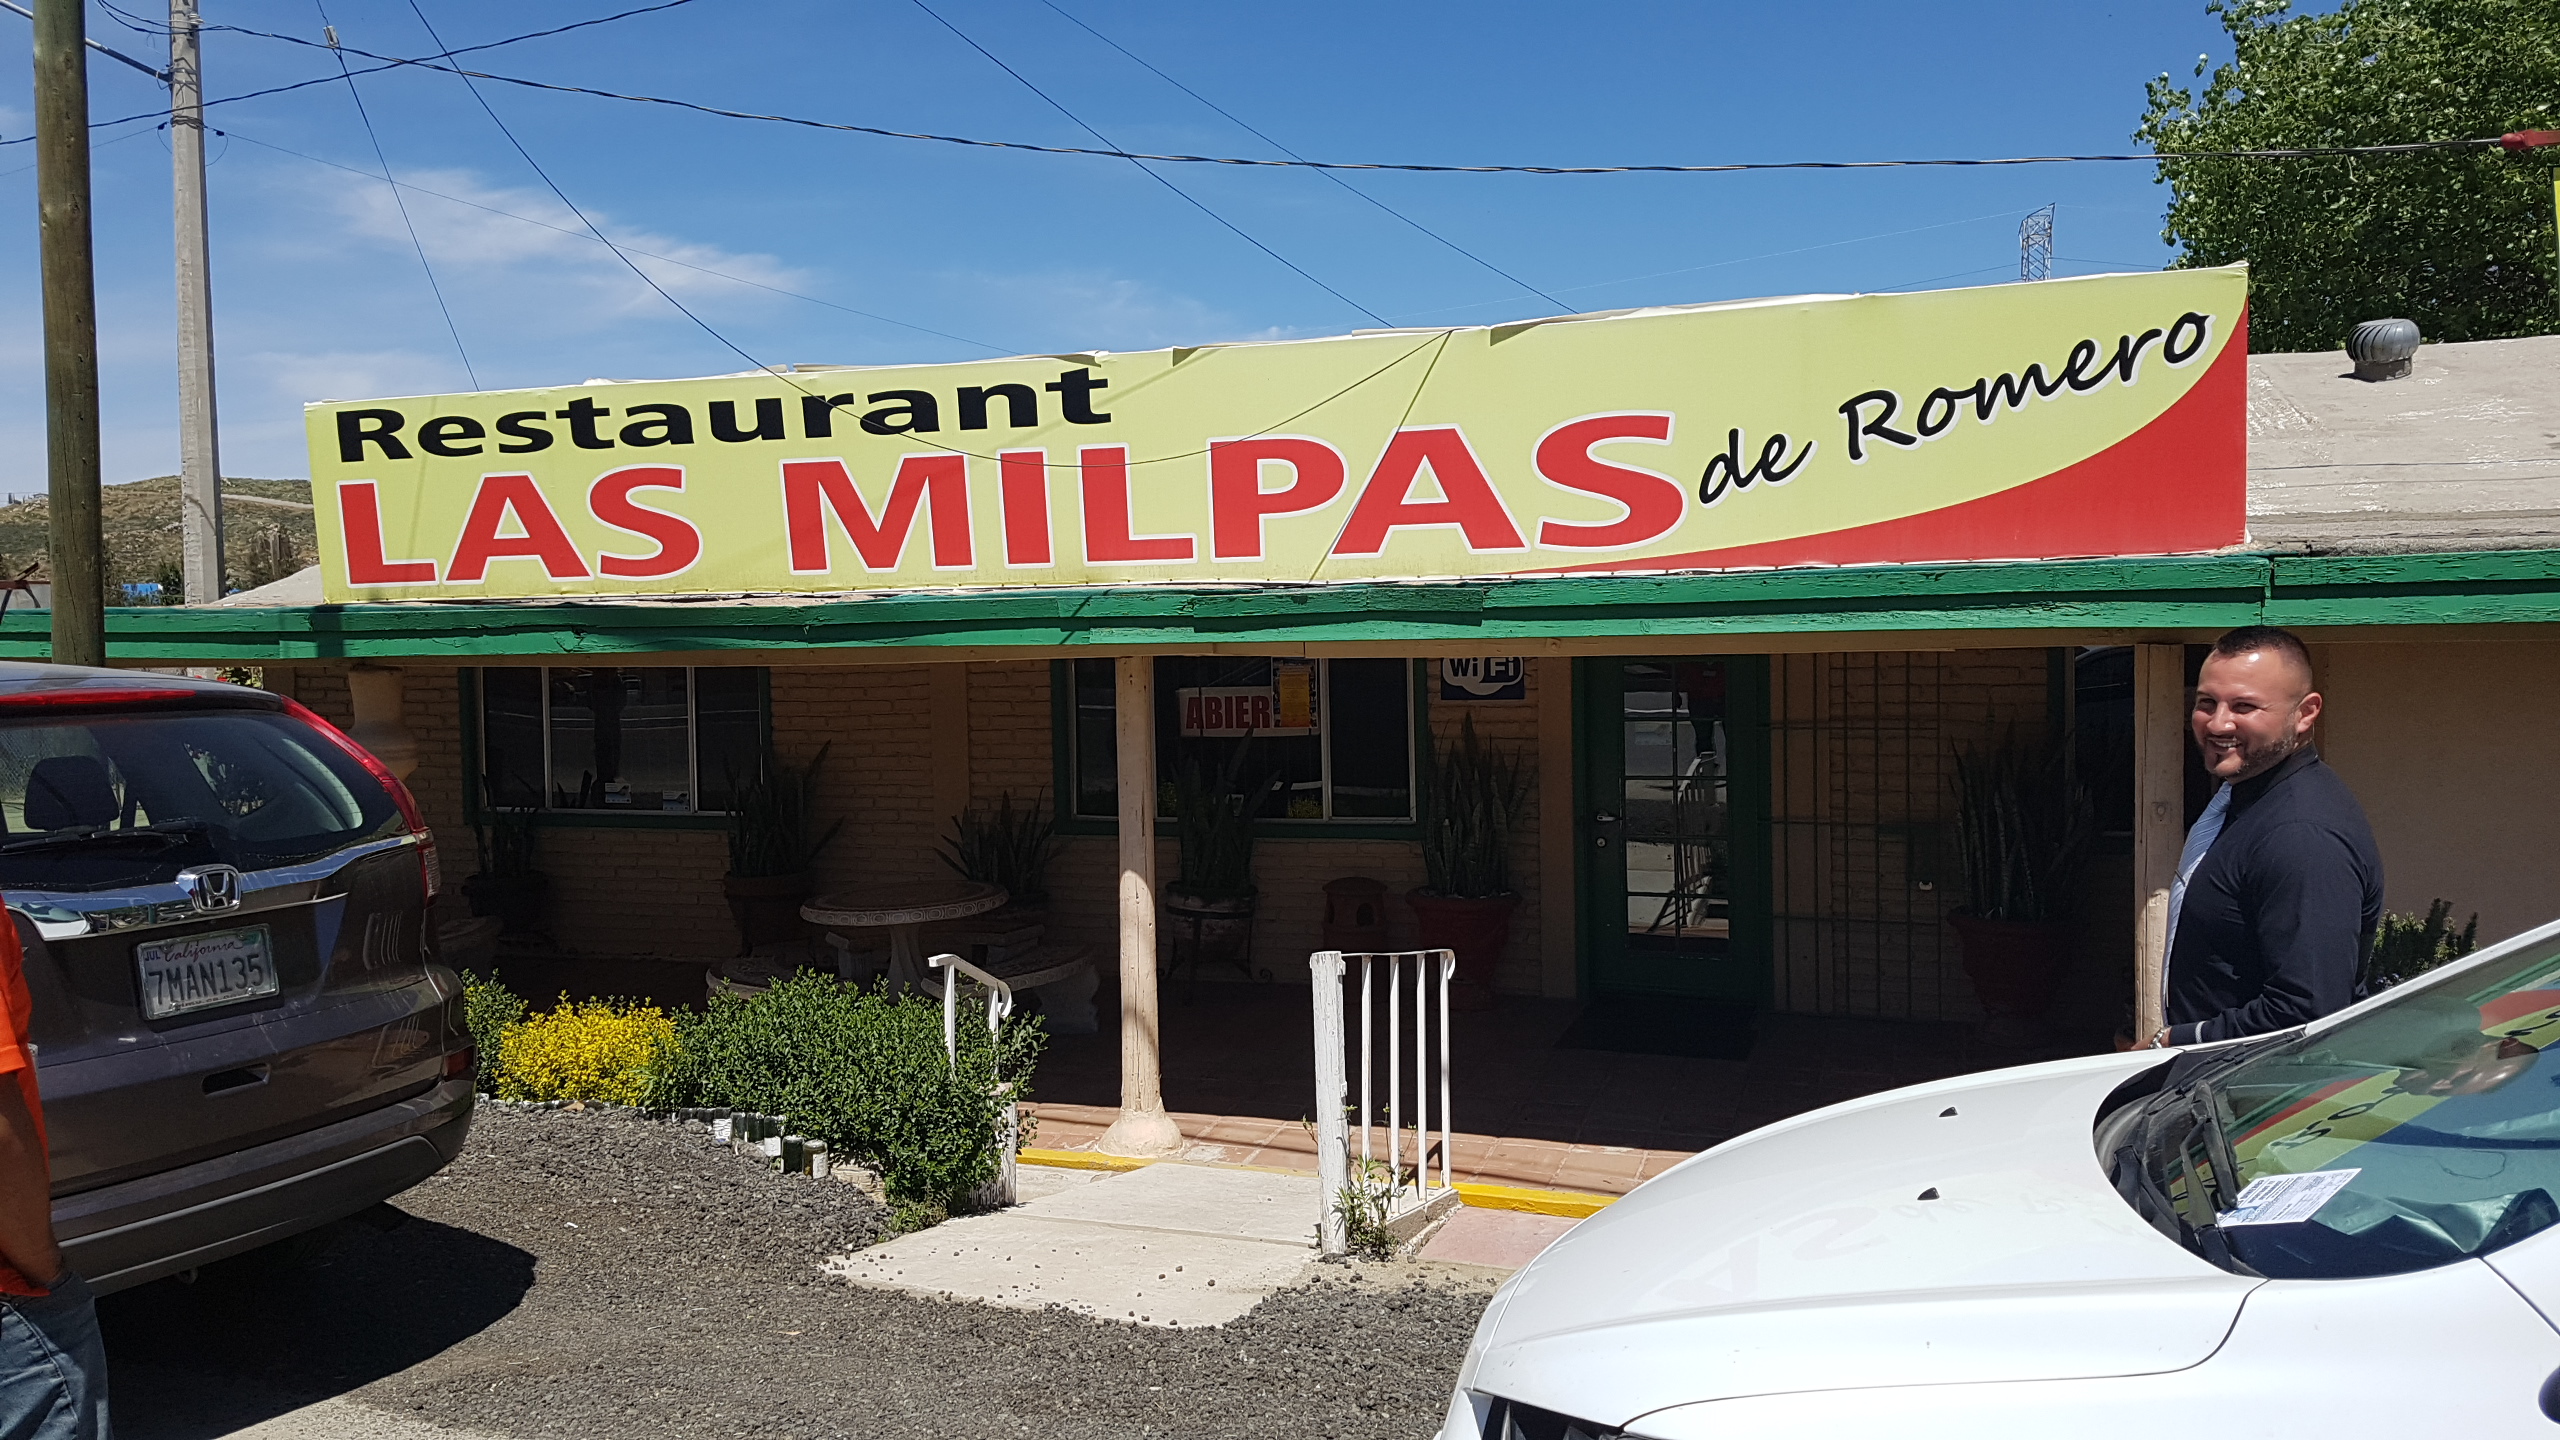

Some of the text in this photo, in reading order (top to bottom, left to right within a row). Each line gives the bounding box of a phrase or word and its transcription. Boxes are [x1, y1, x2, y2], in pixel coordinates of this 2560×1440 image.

[335, 367, 1113, 464] Restaurant
[1699, 311, 2210, 505] de Romero
[338, 412, 1687, 586] LAS MILPAS
[1185, 695, 1271, 729] ABIER
[147, 953, 264, 1006] 7MAN135
[163, 940, 243, 963] California
